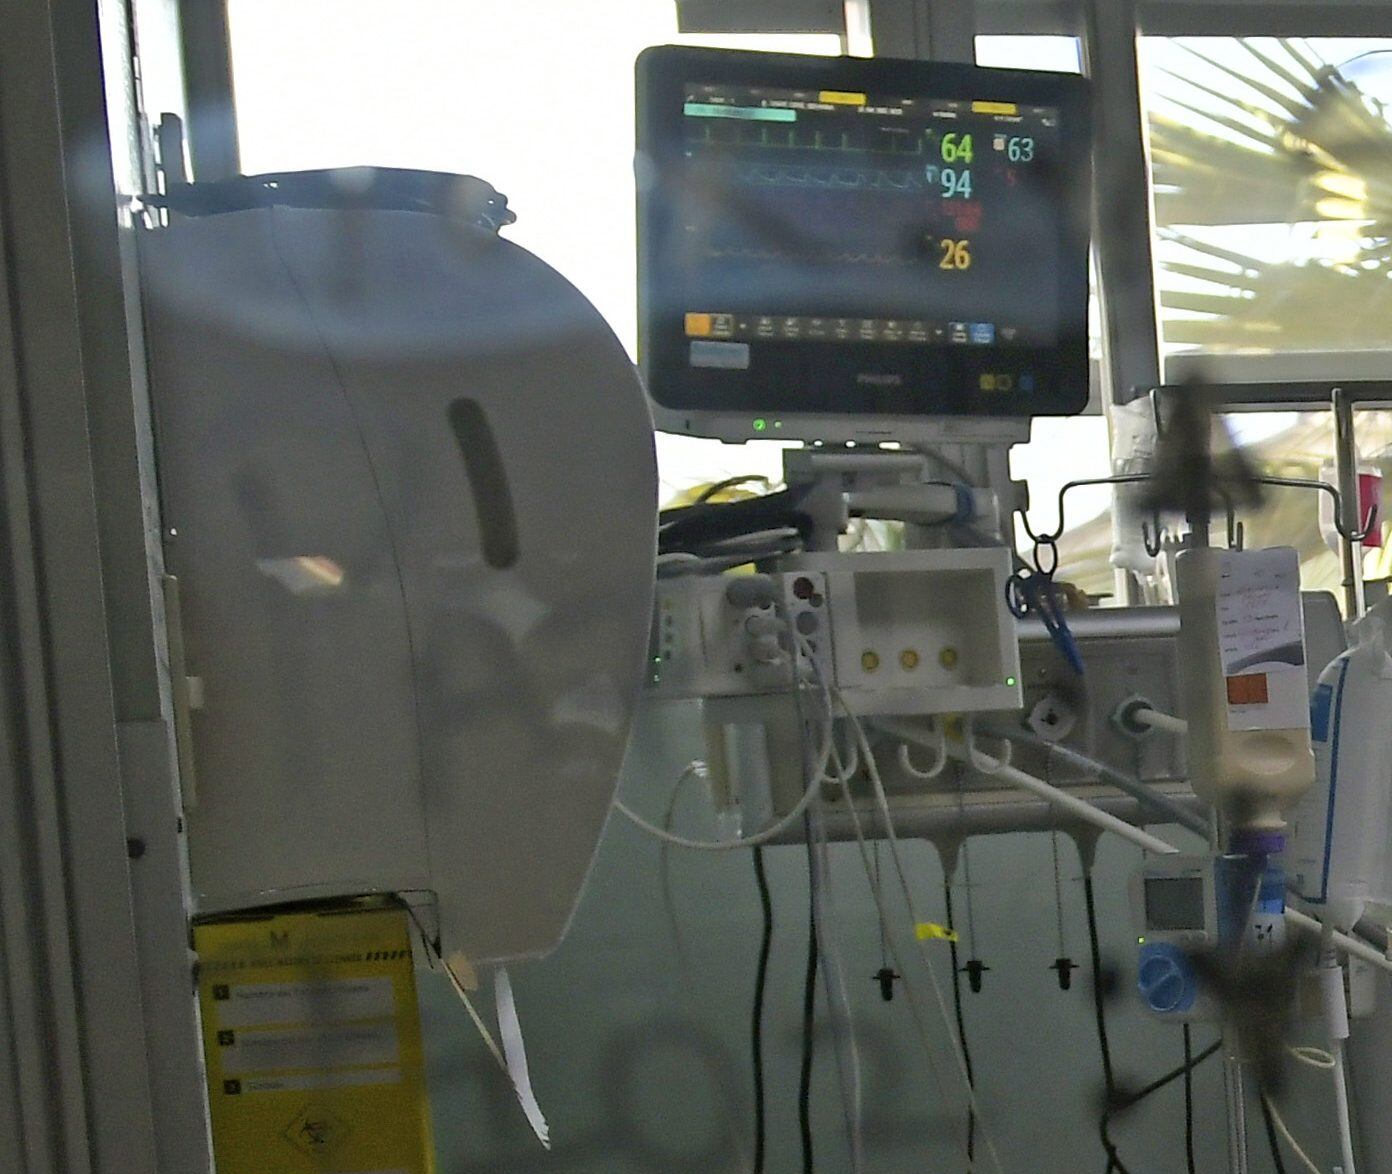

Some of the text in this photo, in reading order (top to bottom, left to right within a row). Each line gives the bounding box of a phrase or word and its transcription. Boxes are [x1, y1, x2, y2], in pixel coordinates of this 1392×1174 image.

[940, 132, 1034, 164] 64 63
[940, 168, 972, 199] 94
[939, 238, 971, 270] 26
